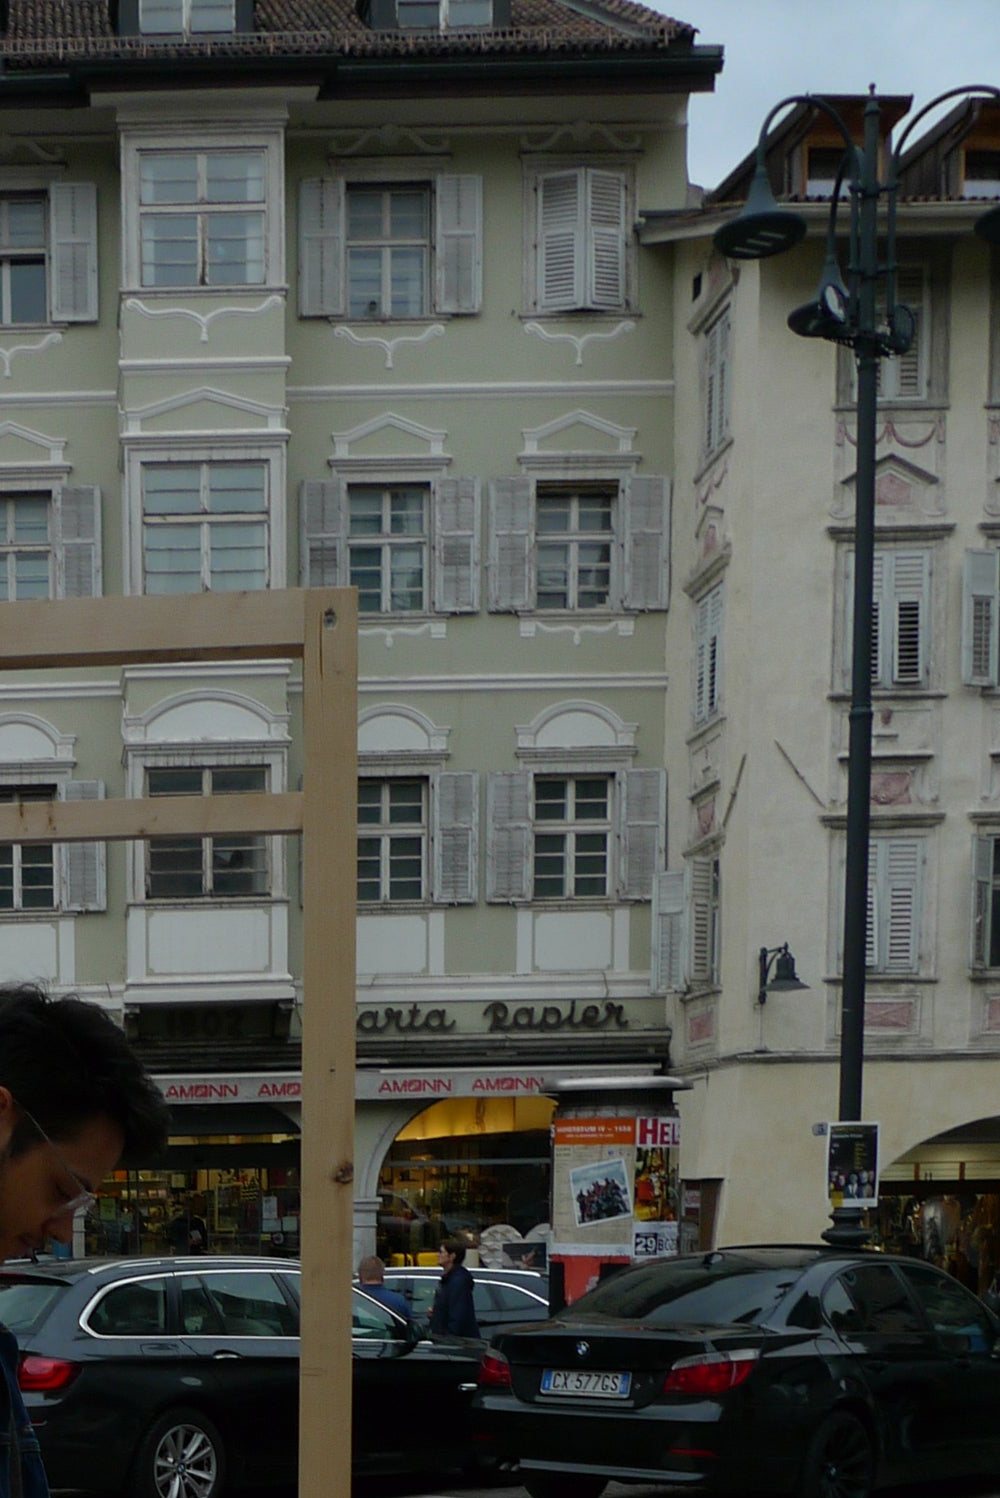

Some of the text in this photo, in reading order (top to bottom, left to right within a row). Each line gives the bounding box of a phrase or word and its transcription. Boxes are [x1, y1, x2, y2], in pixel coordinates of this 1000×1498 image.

[356, 1003, 456, 1033] arta
[166, 1082, 301, 1098] AMONN AMO
[378, 1079, 452, 1093] AMONN
[637, 1236, 657, 1252] 29
